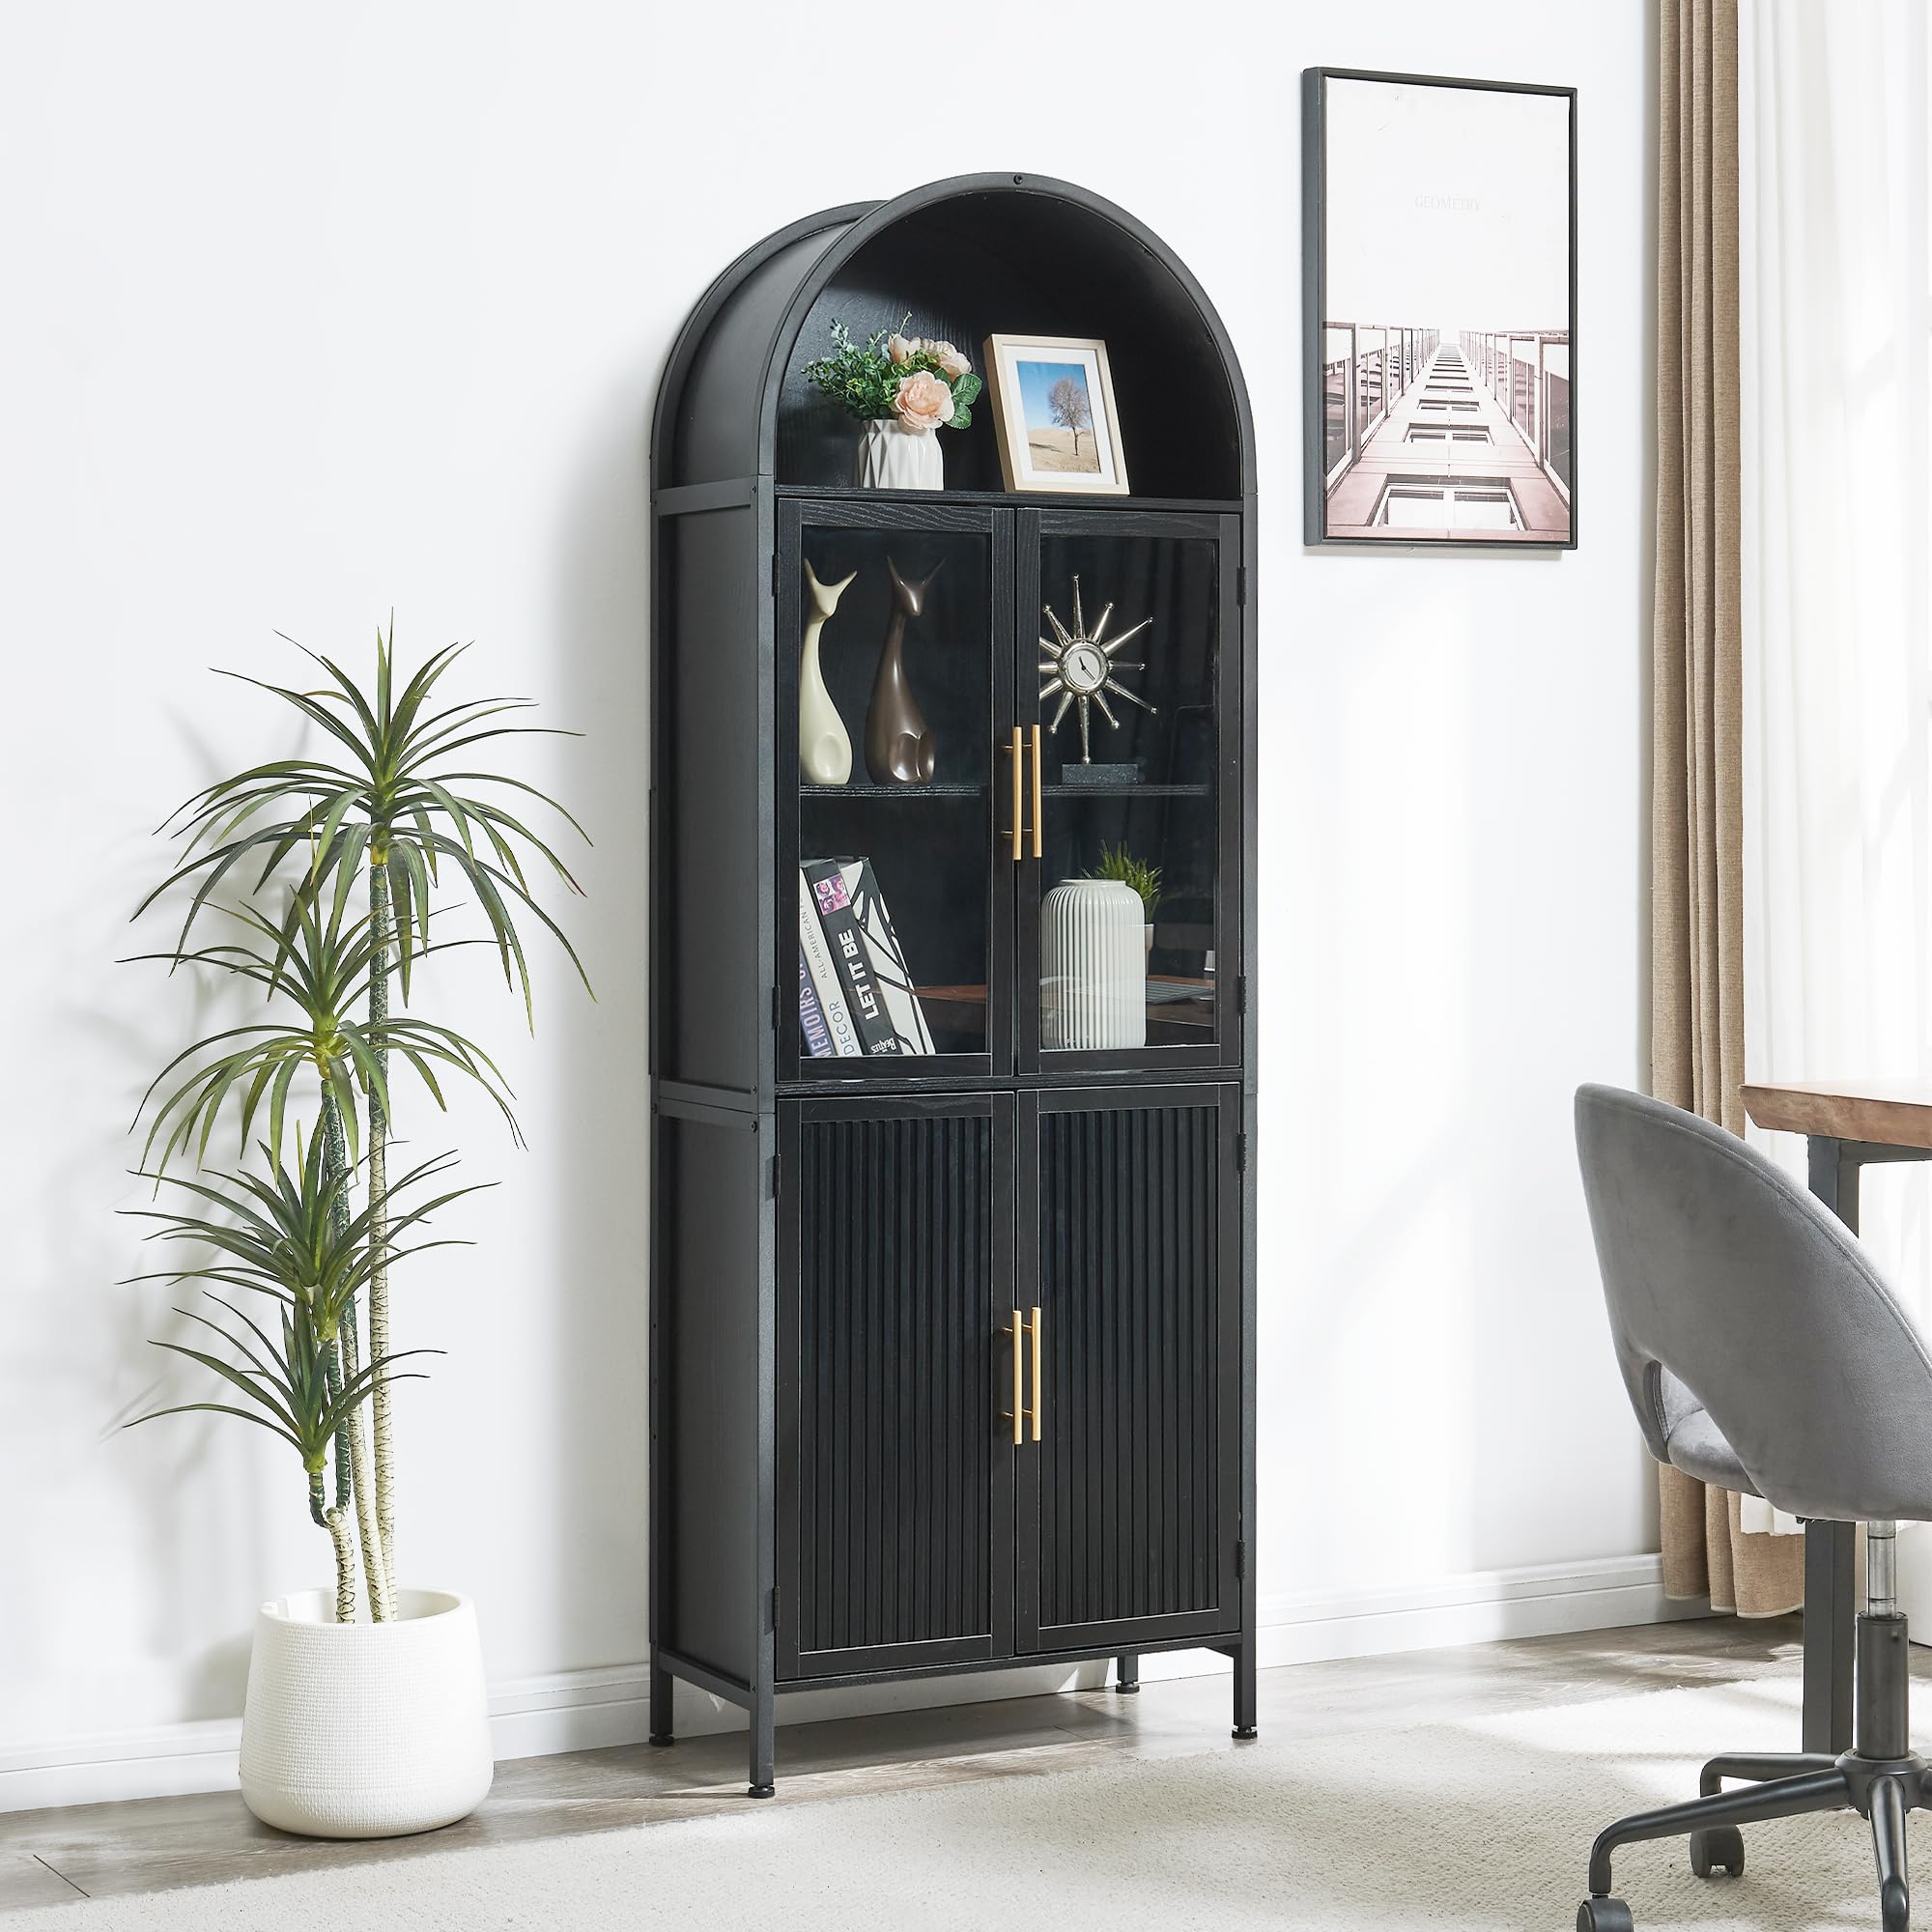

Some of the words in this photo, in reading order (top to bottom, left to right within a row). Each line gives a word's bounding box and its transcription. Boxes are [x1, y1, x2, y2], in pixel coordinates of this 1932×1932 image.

[800, 911, 827, 979] ALL-AMERICAN
[838, 928, 859, 959] BE
[848, 961, 867, 981] IT
[800, 987, 833, 1057] MEMOIRS
[856, 983, 880, 1021] LET
[829, 1000, 856, 1056] DECOR
